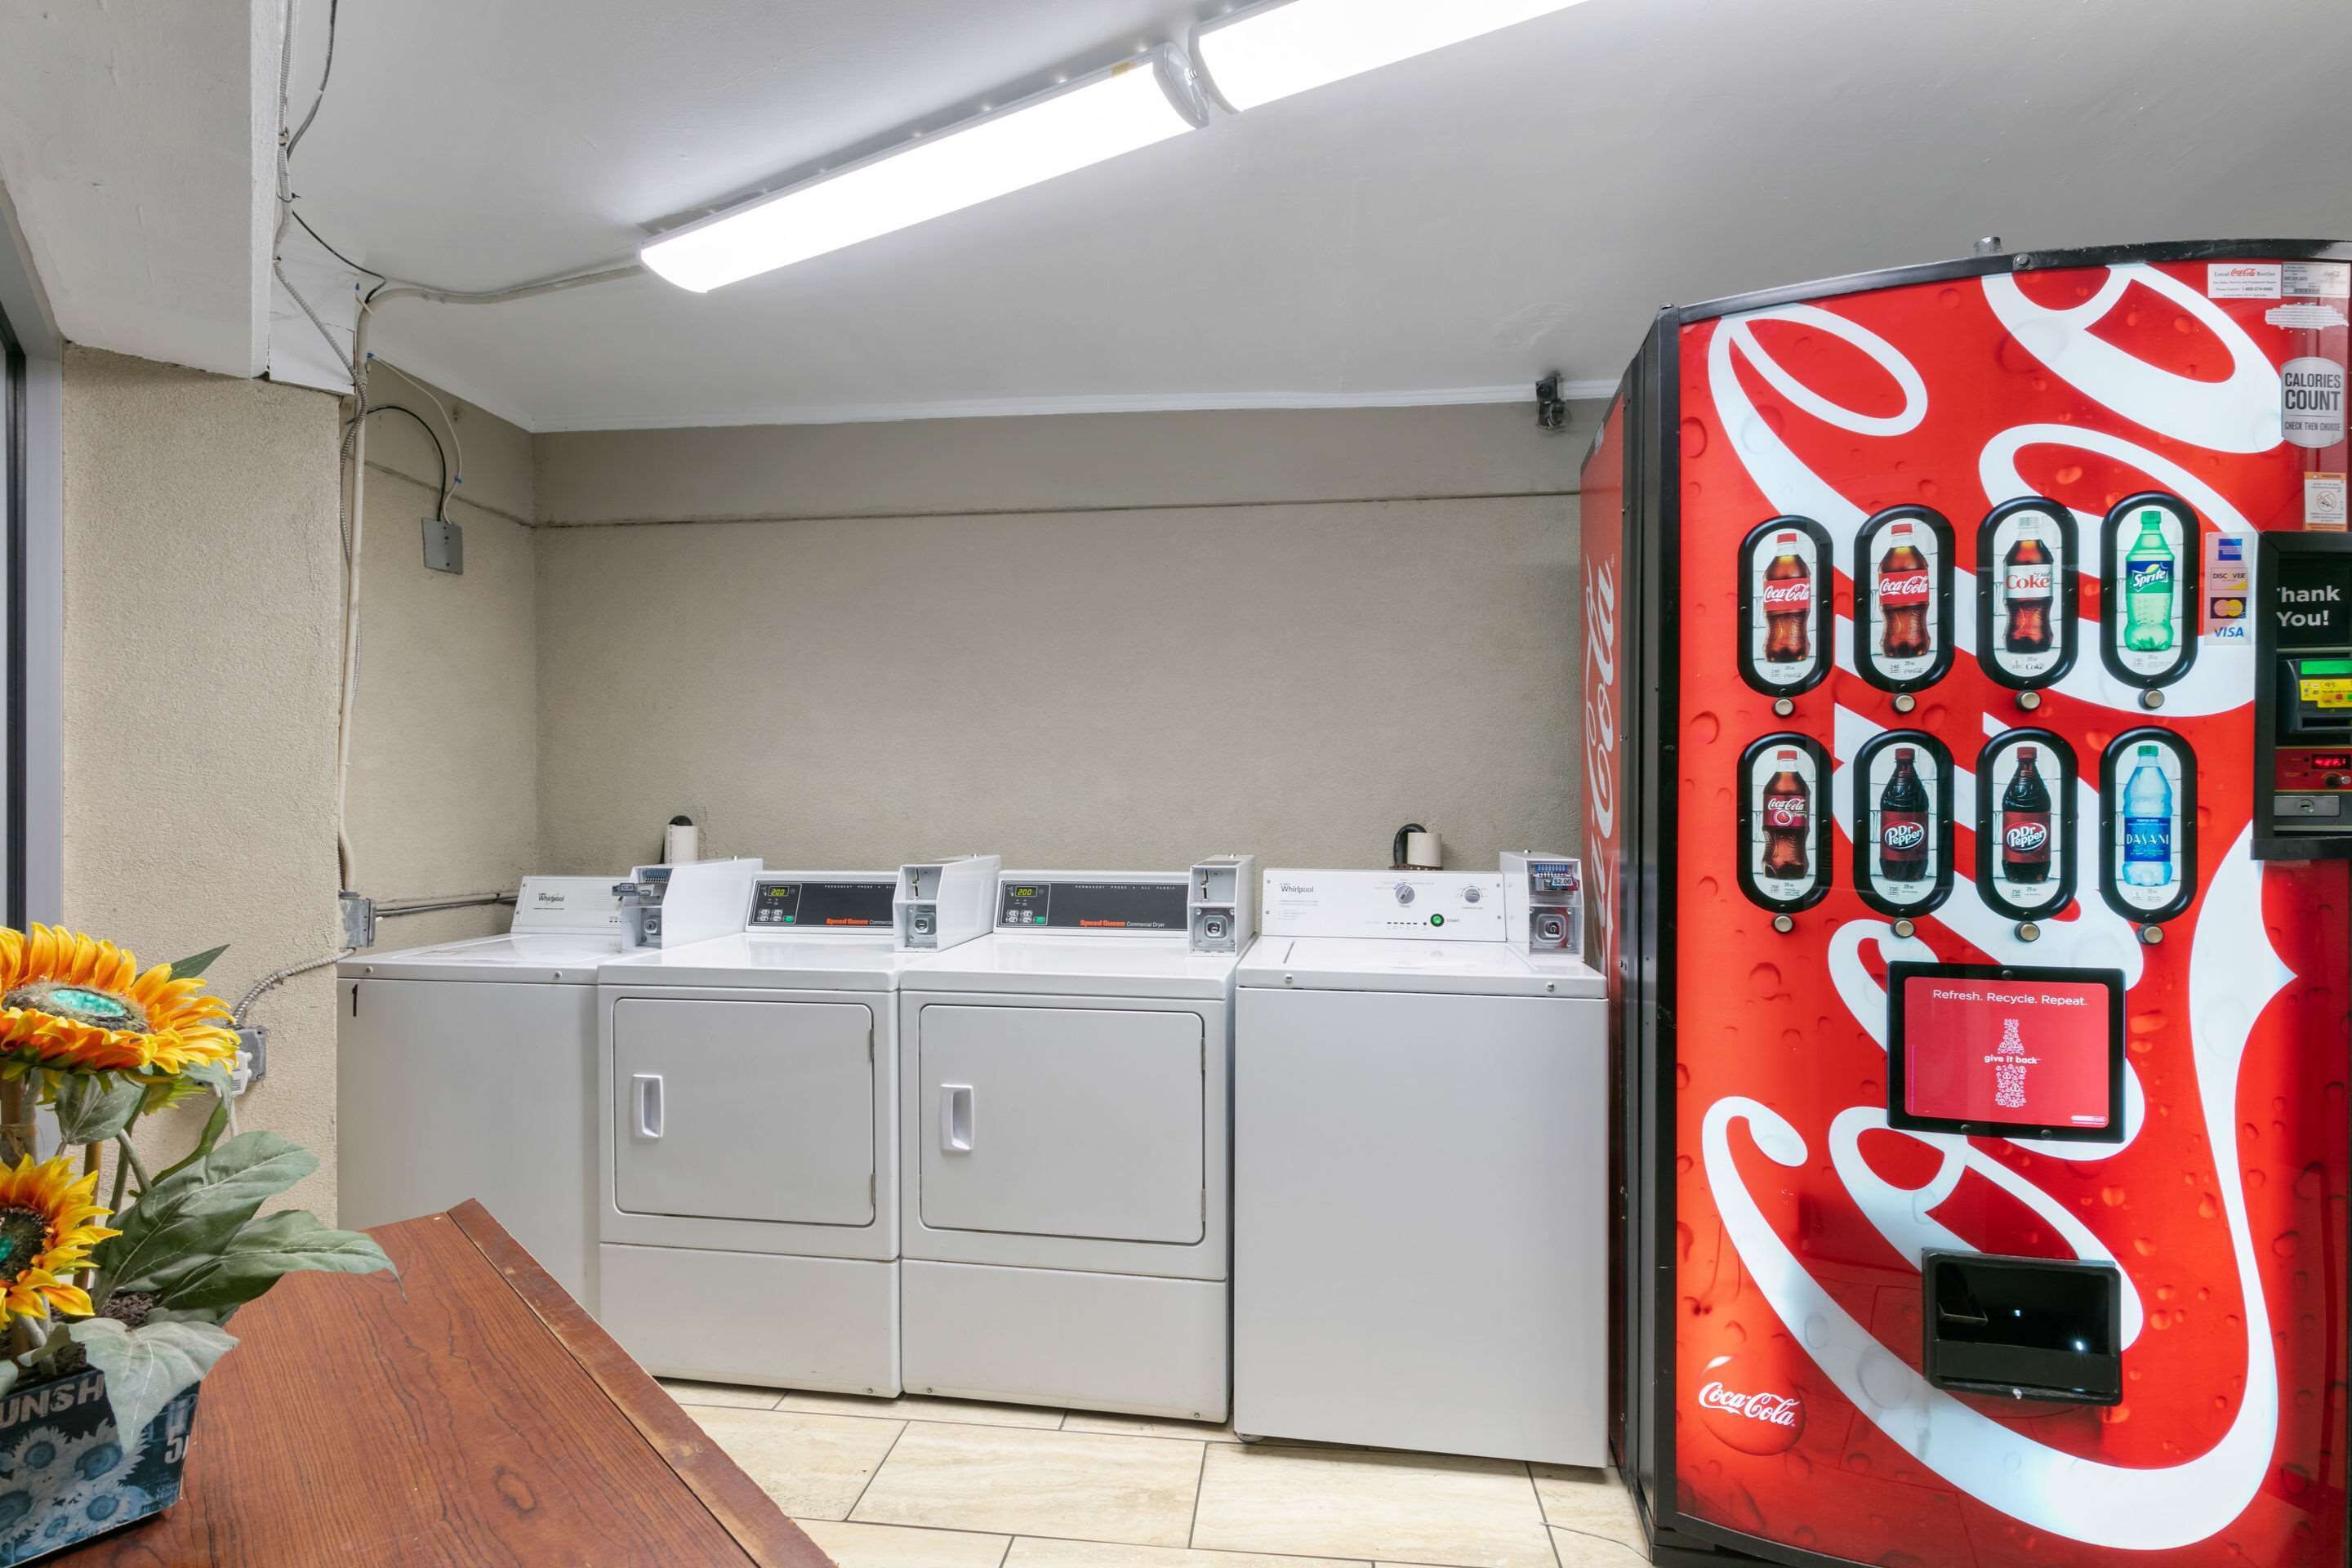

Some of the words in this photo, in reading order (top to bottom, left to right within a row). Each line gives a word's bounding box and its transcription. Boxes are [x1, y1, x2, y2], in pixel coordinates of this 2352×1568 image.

[2284, 372, 2341, 389] CALORIES
[2285, 390, 2341, 411] COUNT
[2284, 421, 2302, 430] CHECK
[2305, 421, 2319, 431] THEN
[2319, 422, 2341, 432] CHOOSE
[1879, 575, 1929, 596] Coca-Cola
[2005, 574, 2051, 590] Coke
[2132, 570, 2167, 588] Sprite
[1763, 583, 1810, 604] Coca-Cola
[2276, 586, 2341, 604] hank
[2276, 610, 2330, 628] You!
[2214, 626, 2245, 638] VISA
[1767, 798, 1806, 811] Coca-Cola
[1888, 828, 1922, 847] Pepper
[1897, 825, 1914, 835] Dr
[2010, 828, 2045, 848] Pepper
[2020, 825, 2037, 835] Dr
[2126, 833, 2170, 845] DASANI
[537, 893, 565, 902] Whirlpool
[1281, 885, 1314, 894] Whirlpool
[1932, 990, 1983, 1001] Refresh.
[1986, 993, 2038, 1005] Recycle.
[2041, 995, 2088, 1007] Repeat.
[1984, 1055, 2004, 1065] give
[2006, 1055, 2014, 1063] it
[1698, 1381, 1802, 1427] Coca-Cola
